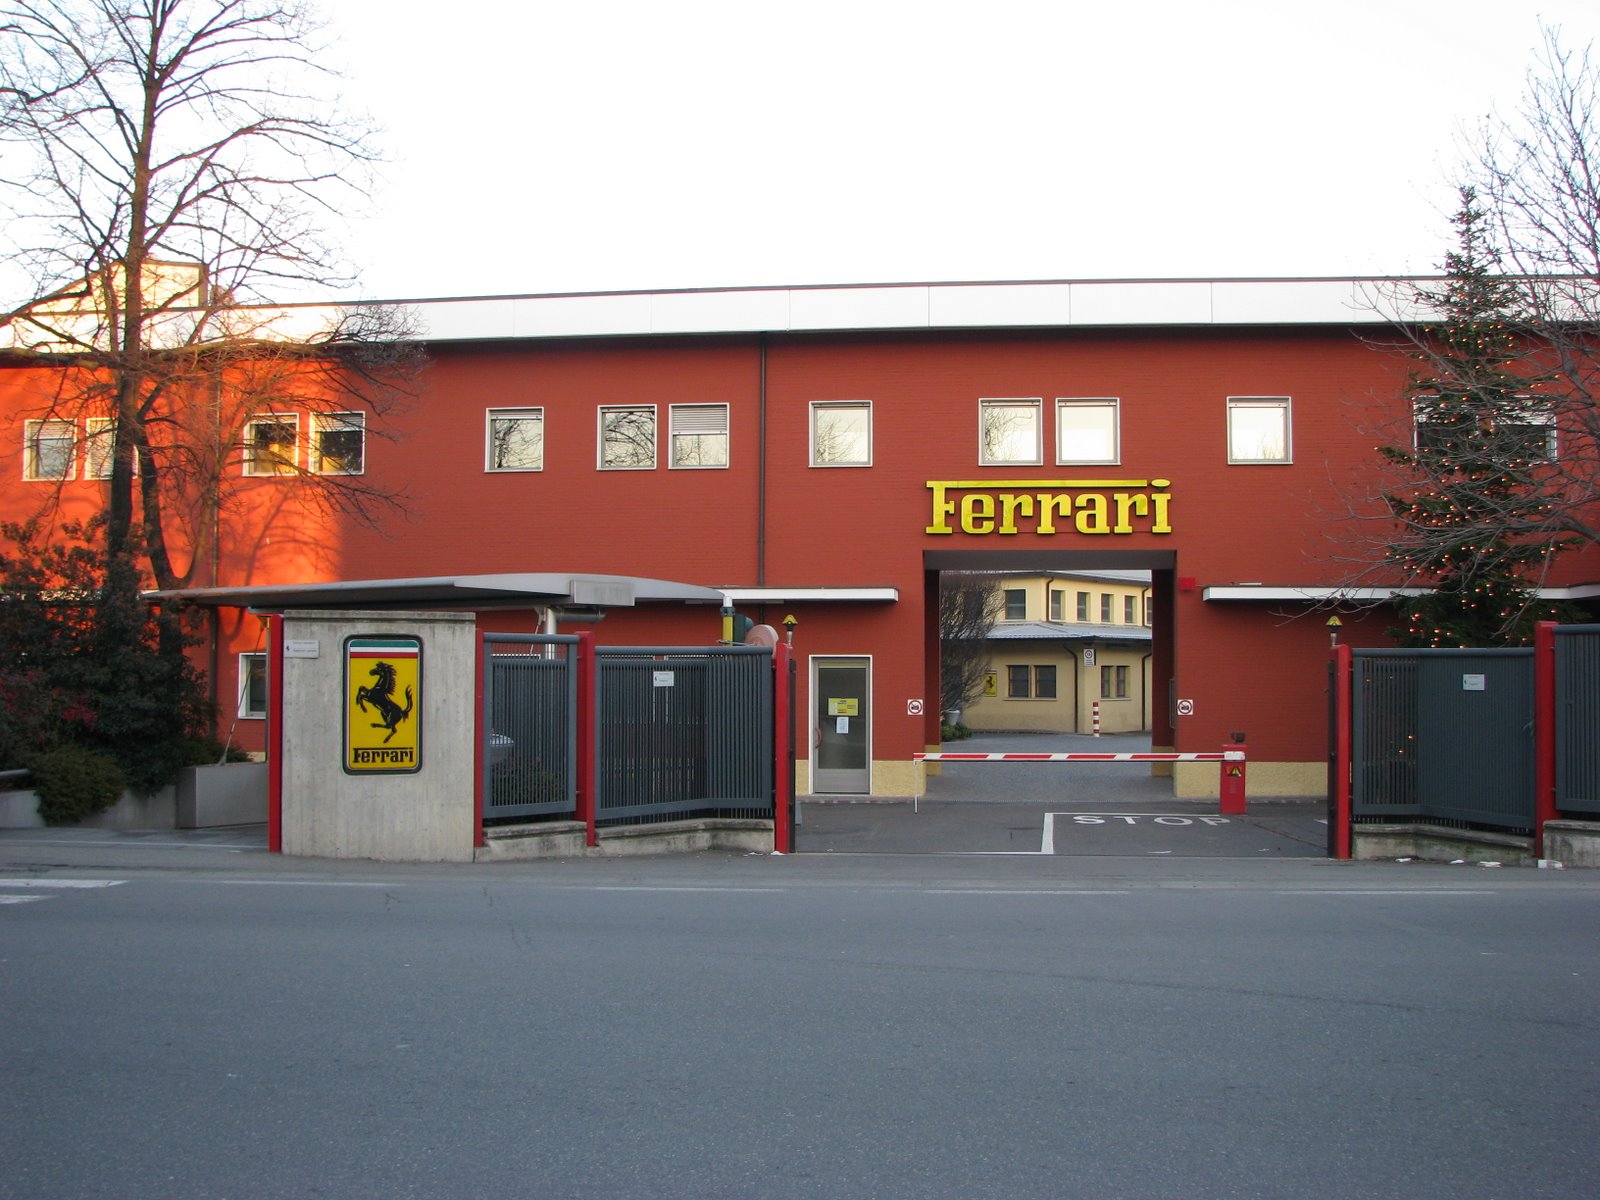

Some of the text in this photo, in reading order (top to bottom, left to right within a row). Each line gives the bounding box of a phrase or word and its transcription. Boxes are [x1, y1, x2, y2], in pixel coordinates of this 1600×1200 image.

[925, 478, 1172, 534] Ferrari
[353, 747, 414, 763] Ferrari
[1073, 815, 1231, 826] STOP
